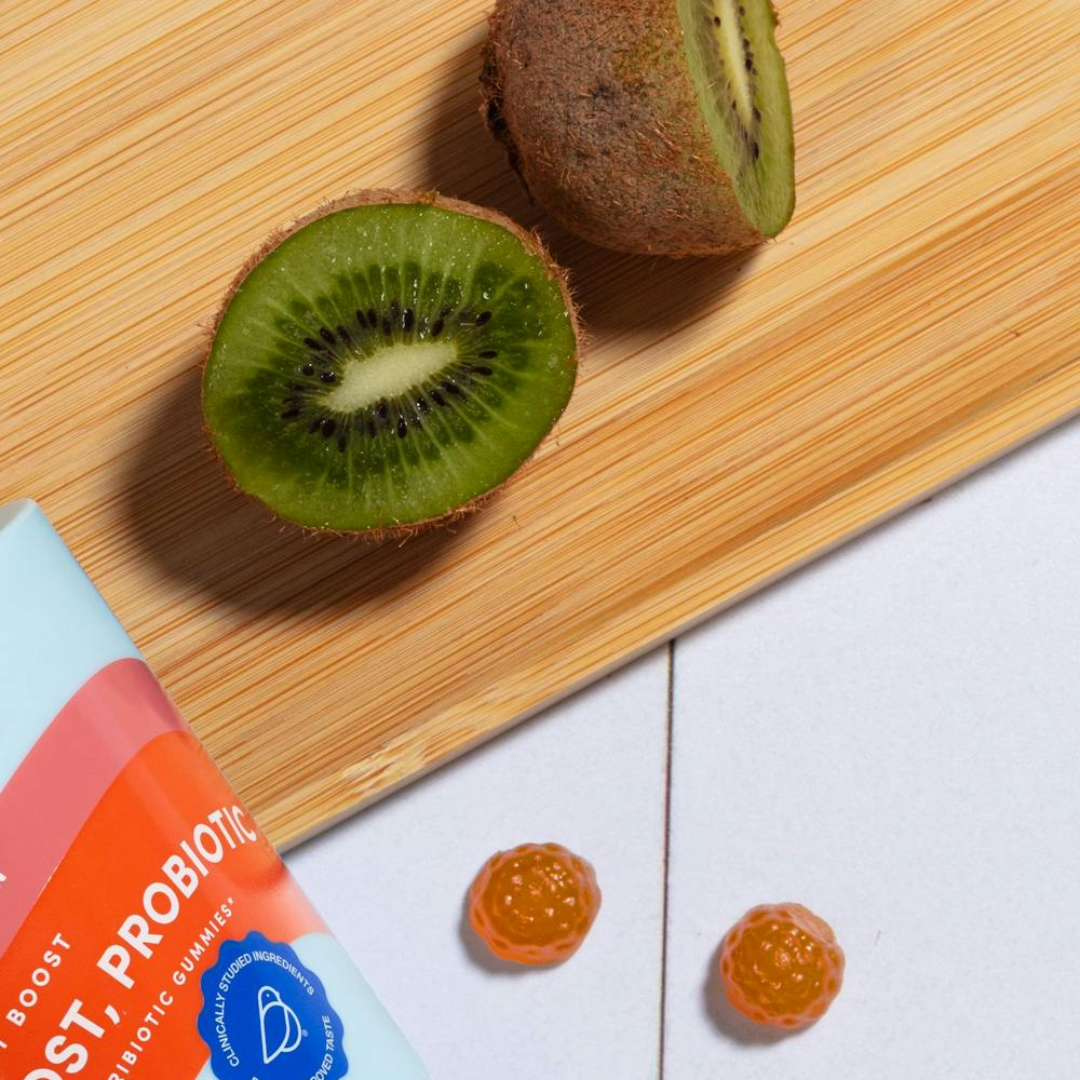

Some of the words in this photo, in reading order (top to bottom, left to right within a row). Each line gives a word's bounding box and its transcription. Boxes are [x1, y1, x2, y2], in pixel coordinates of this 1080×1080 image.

[96, 805, 257, 990] PROBIOTIC
[6, 933, 70, 1027] BOOST
[218, 952, 252, 992] STUDIED
[252, 950, 314, 996] INGREDIENTS
[214, 992, 240, 1068] CLINICALLY
[321, 1015, 335, 1051] TASTE
